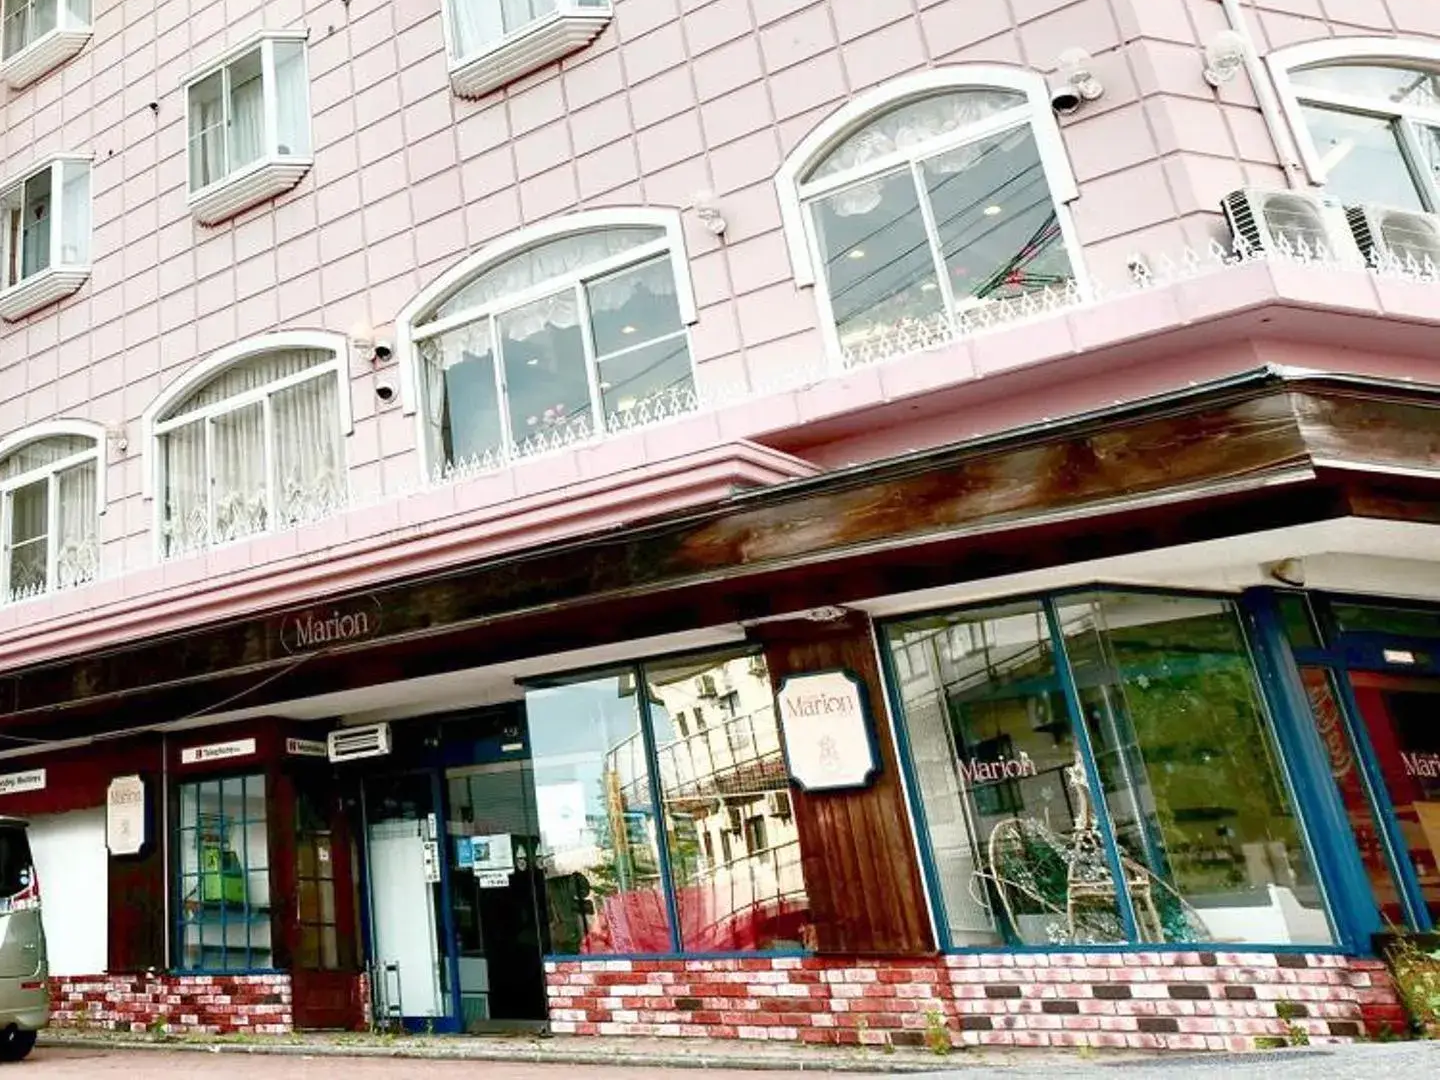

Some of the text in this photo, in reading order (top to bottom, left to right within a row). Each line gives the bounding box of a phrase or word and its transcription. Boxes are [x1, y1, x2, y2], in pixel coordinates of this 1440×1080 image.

[296, 610, 368, 647] Marion
[787, 693, 854, 718] Marion
[956, 754, 1037, 782] Marion
